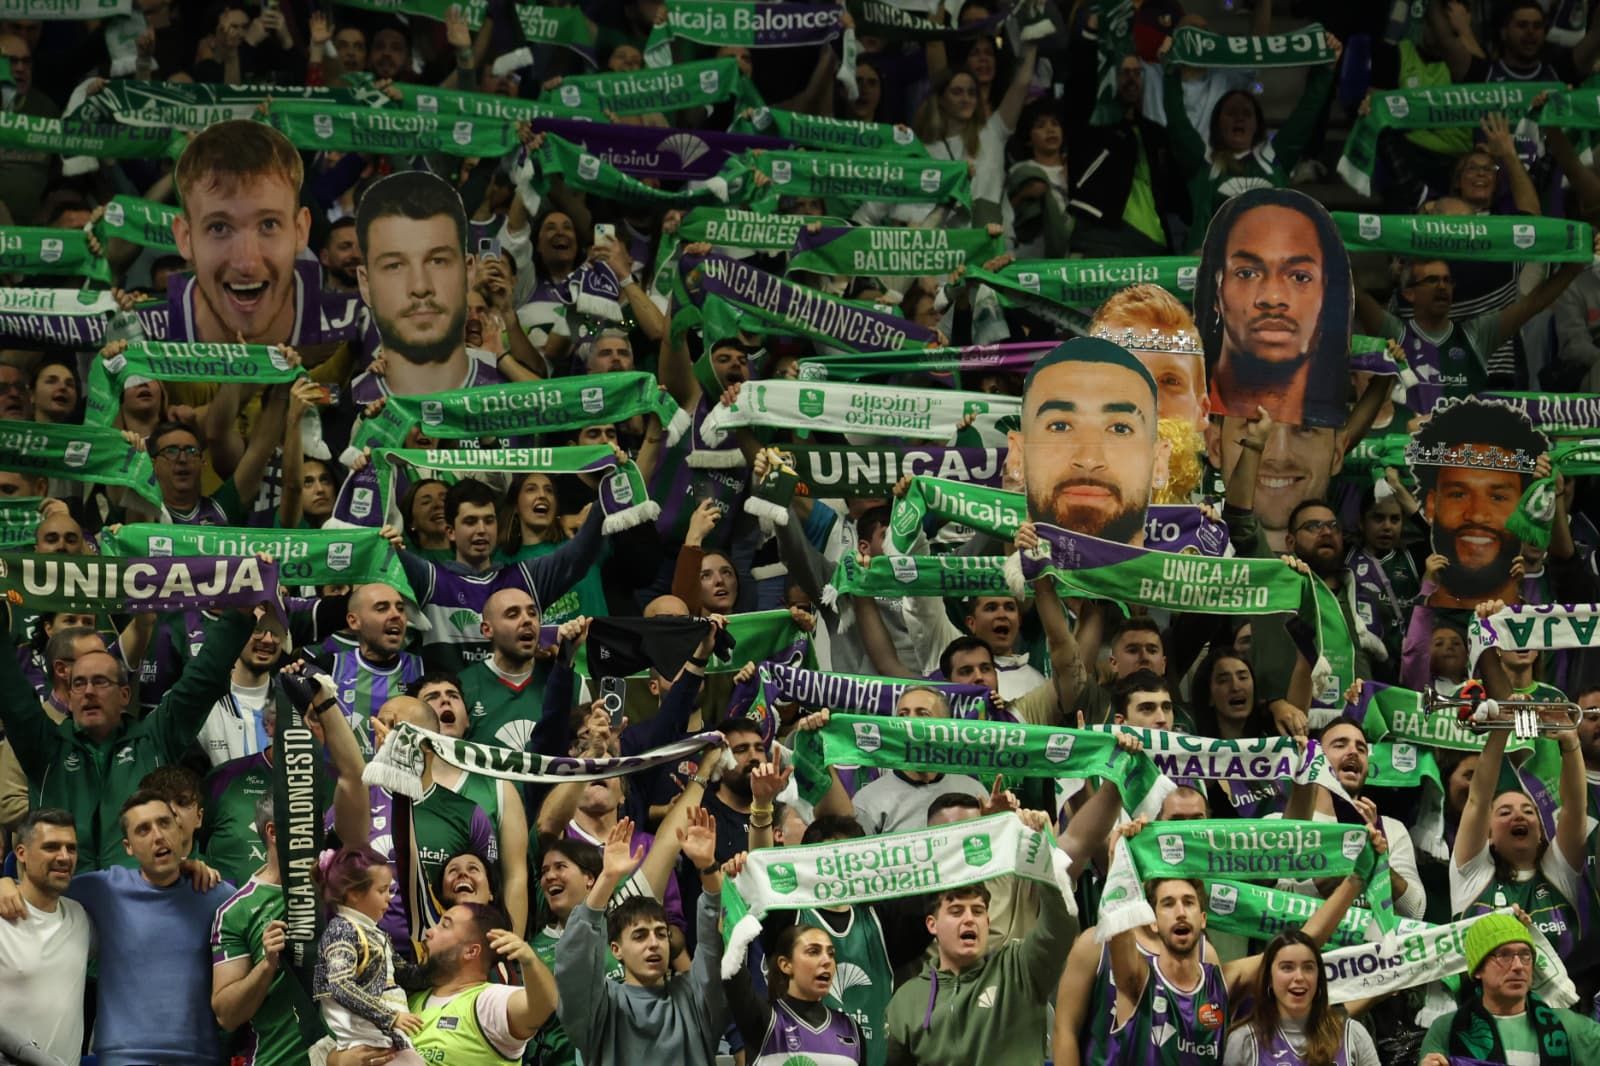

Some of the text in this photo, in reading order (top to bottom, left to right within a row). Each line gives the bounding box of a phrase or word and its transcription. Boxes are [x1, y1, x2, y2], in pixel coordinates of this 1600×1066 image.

[597, 71, 684, 97] Unicaja
[1424, 86, 1524, 107] Unicaja
[349, 111, 438, 135] Unicaja
[811, 158, 905, 185] Unicaja
[870, 229, 949, 250] UNICAJA
[1412, 219, 1489, 239] Unicaja
[854, 249, 966, 271] BALONCESTO
[1060, 262, 1160, 286] Unicaja
[704, 258, 906, 351] UNICAJA BALONCESTO
[143, 342, 248, 363] Unicaja
[463, 387, 563, 415] Unicaja
[427, 447, 553, 466] BALONCESTO
[920, 481, 1019, 528] Unicaja
[197, 534, 309, 563] Unicaja
[22, 557, 265, 599] UNICAJA
[1163, 558, 1251, 585] UNICAJA
[1139, 578, 1269, 608] BALONCESTO
[1504, 616, 1599, 647] AJA
[905, 719, 1027, 751] Unicaja
[904, 741, 1029, 769] histórico
[1154, 753, 1292, 778] MALAGA
[283, 728, 314, 851] BALONCESTO
[1207, 825, 1322, 857] Unicaja
[1208, 849, 1328, 873] histórico
[286, 857, 316, 942] UNICAJA
